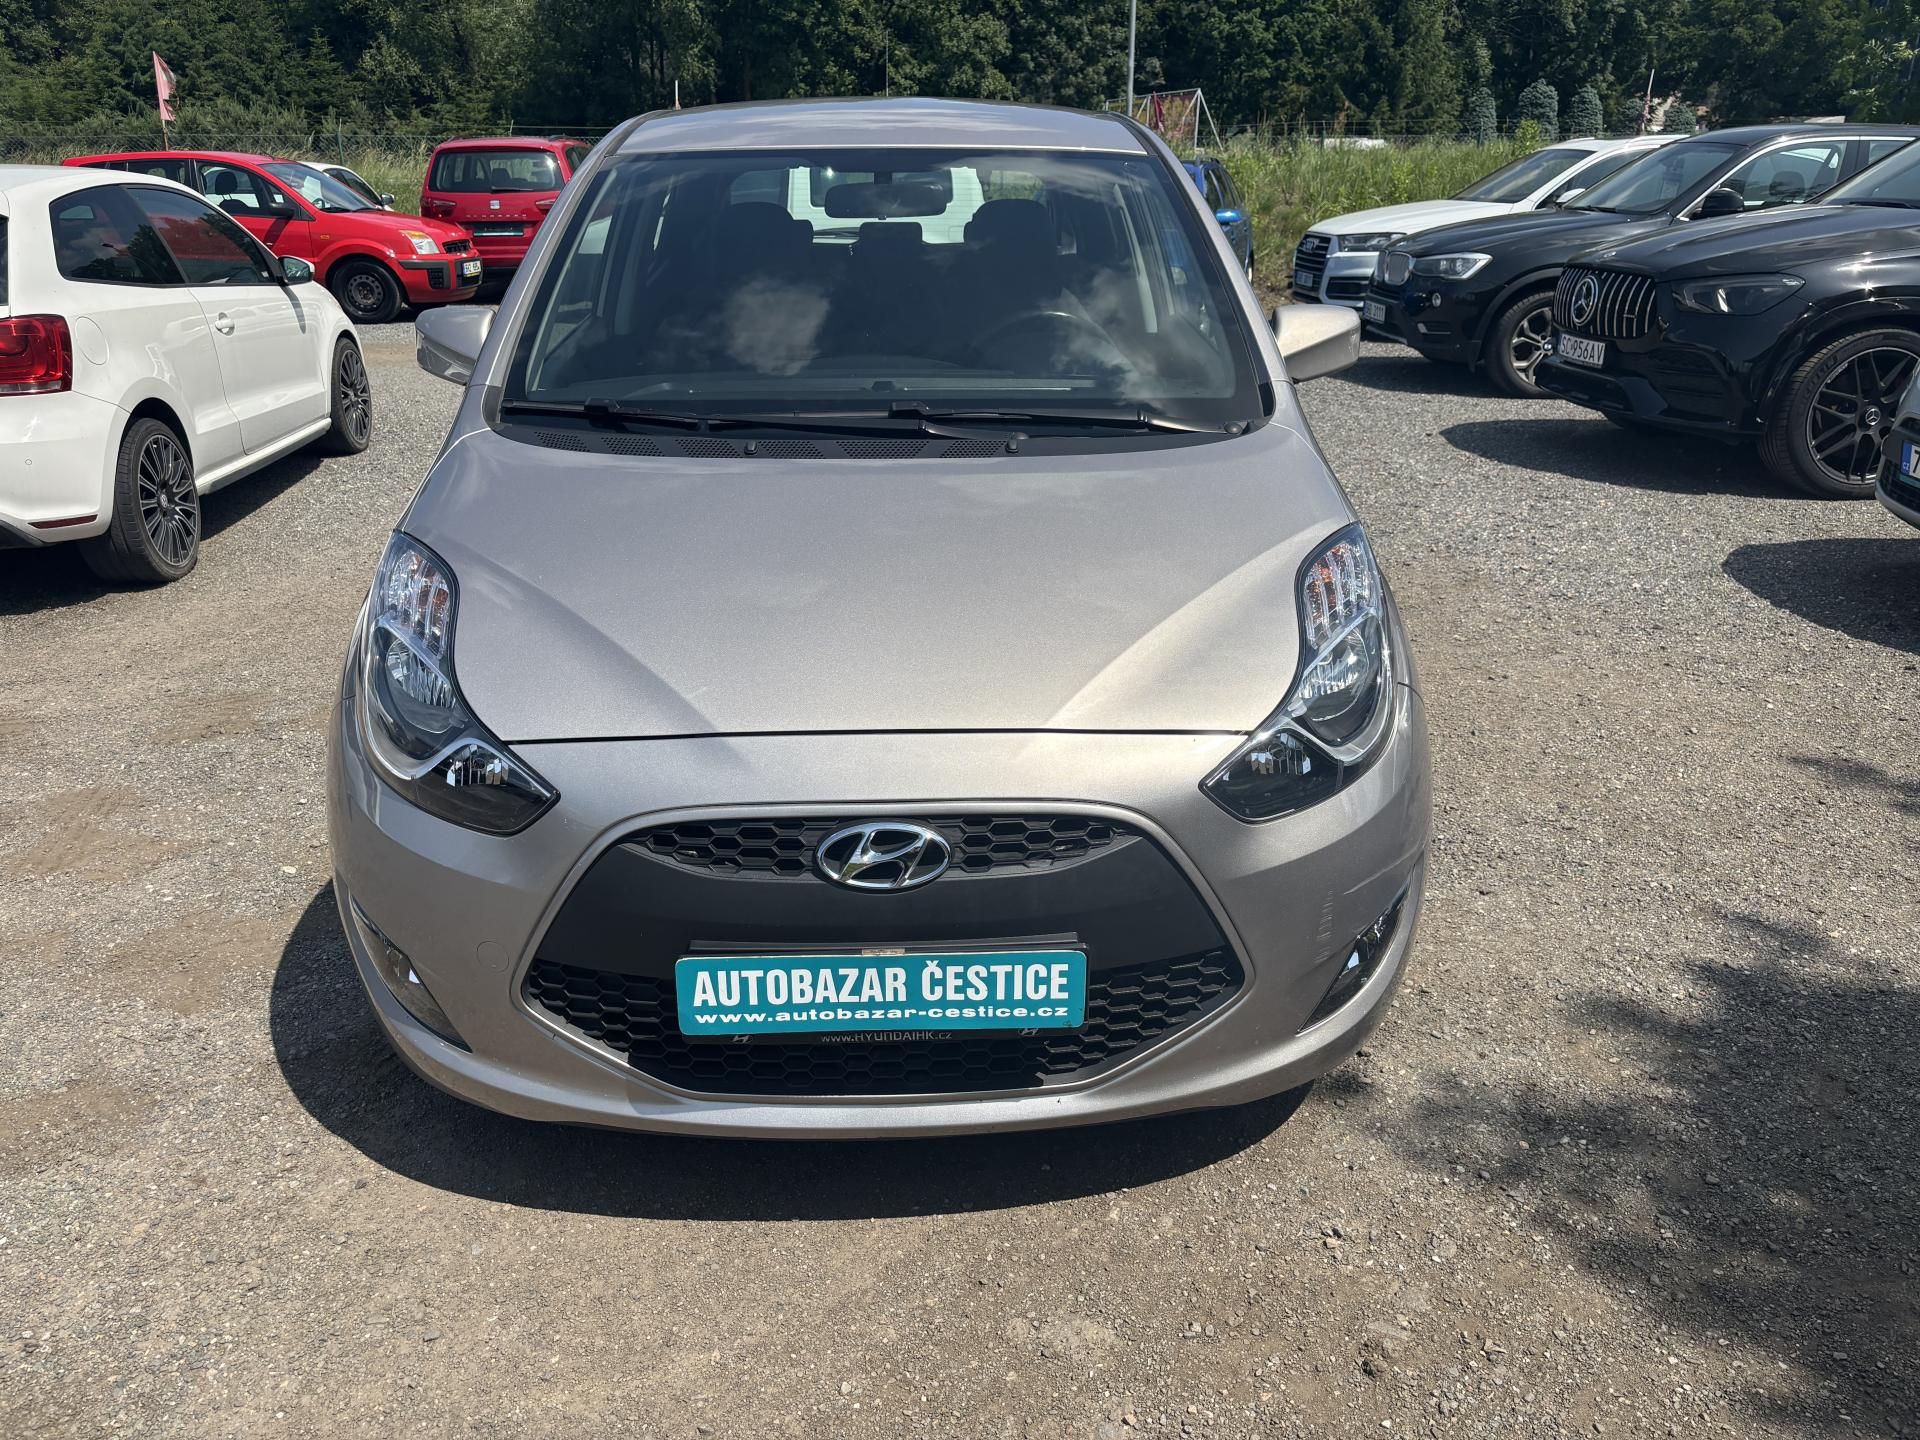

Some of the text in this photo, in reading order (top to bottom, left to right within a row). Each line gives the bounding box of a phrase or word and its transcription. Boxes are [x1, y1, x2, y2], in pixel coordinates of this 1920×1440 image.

[693, 960, 1069, 1007] AUTOBAZAR ČESTICE
[694, 1006, 1069, 1024] www.autobazar-cestice.cz
